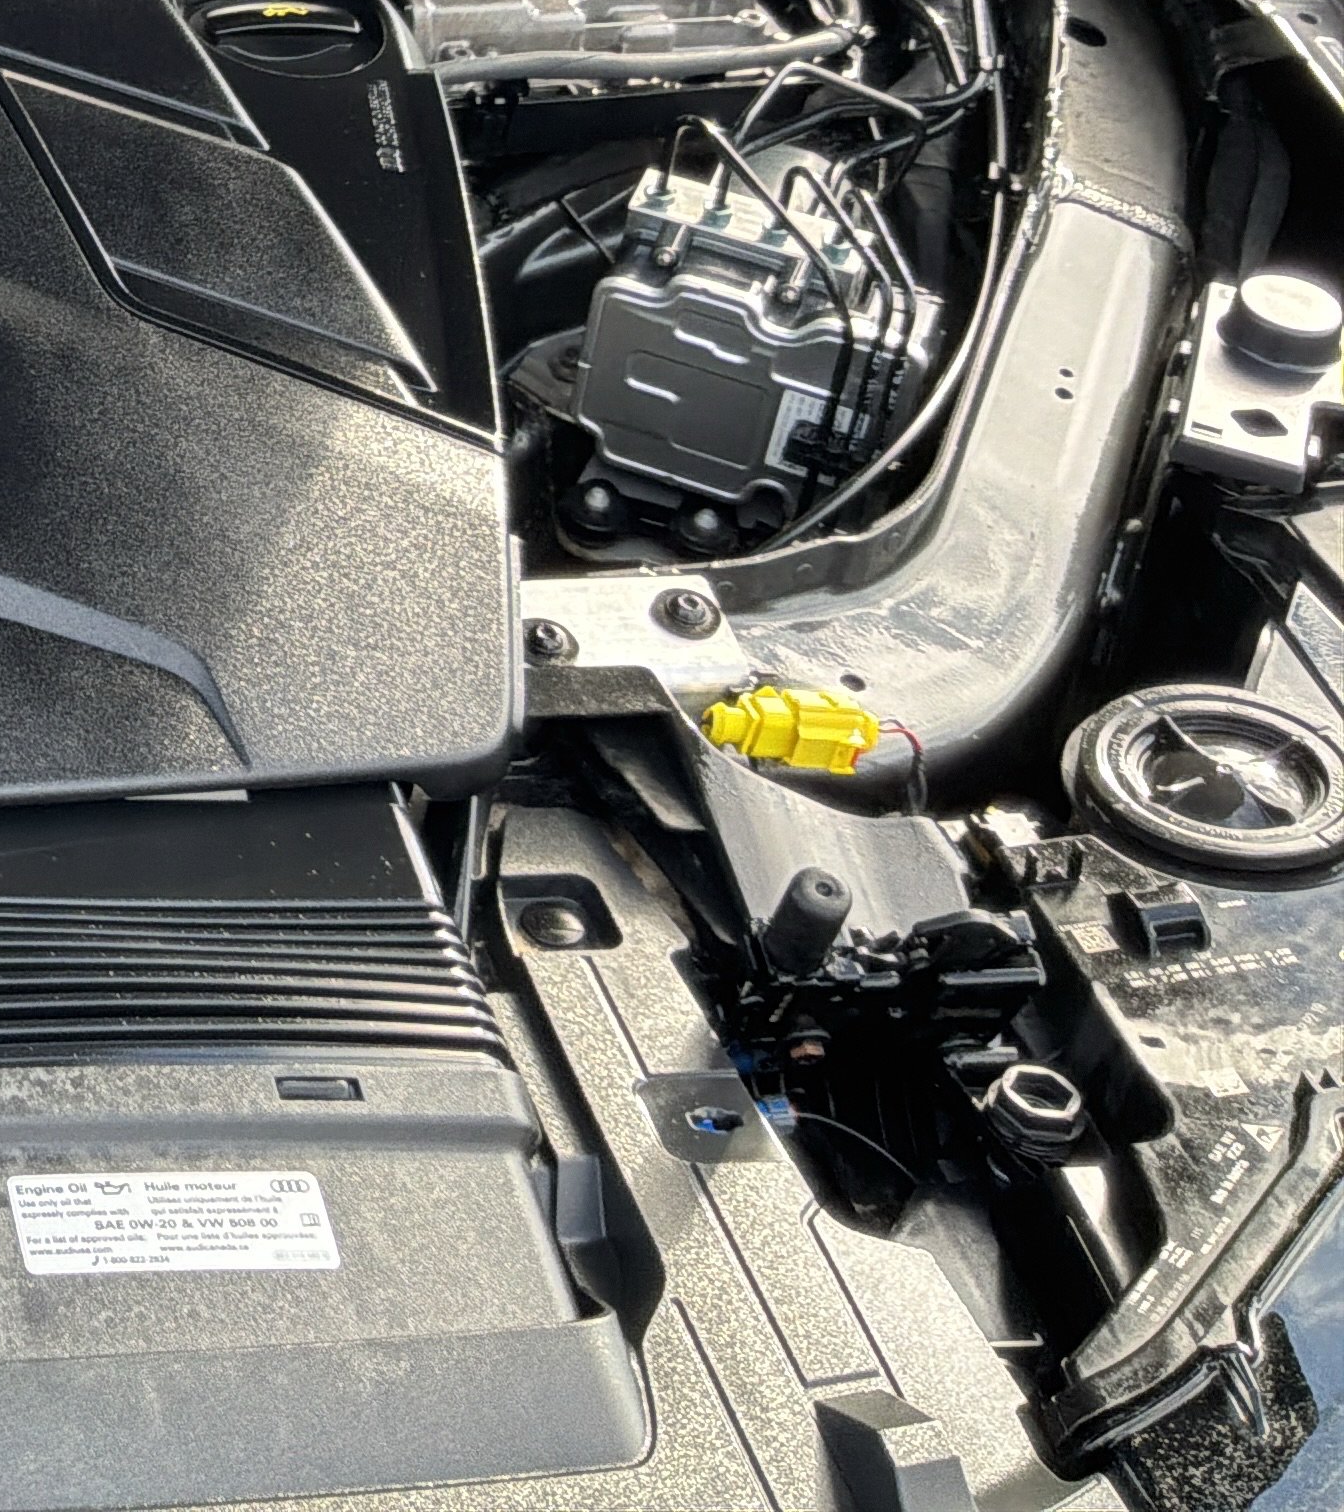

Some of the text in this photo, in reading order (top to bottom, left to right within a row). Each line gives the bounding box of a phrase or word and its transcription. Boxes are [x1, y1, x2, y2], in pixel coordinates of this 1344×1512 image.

[16, 1183, 88, 1196] Engine Oil
[144, 1181, 237, 1192] Huile moteur
[18, 1198, 92, 1208] Use only oil that
[94, 1218, 278, 1231] SAE 0W-20 & VW 508 00
[26, 1236, 42, 1244] For
[53, 1235, 67, 1243] list
[69, 1235, 79, 1243] of
